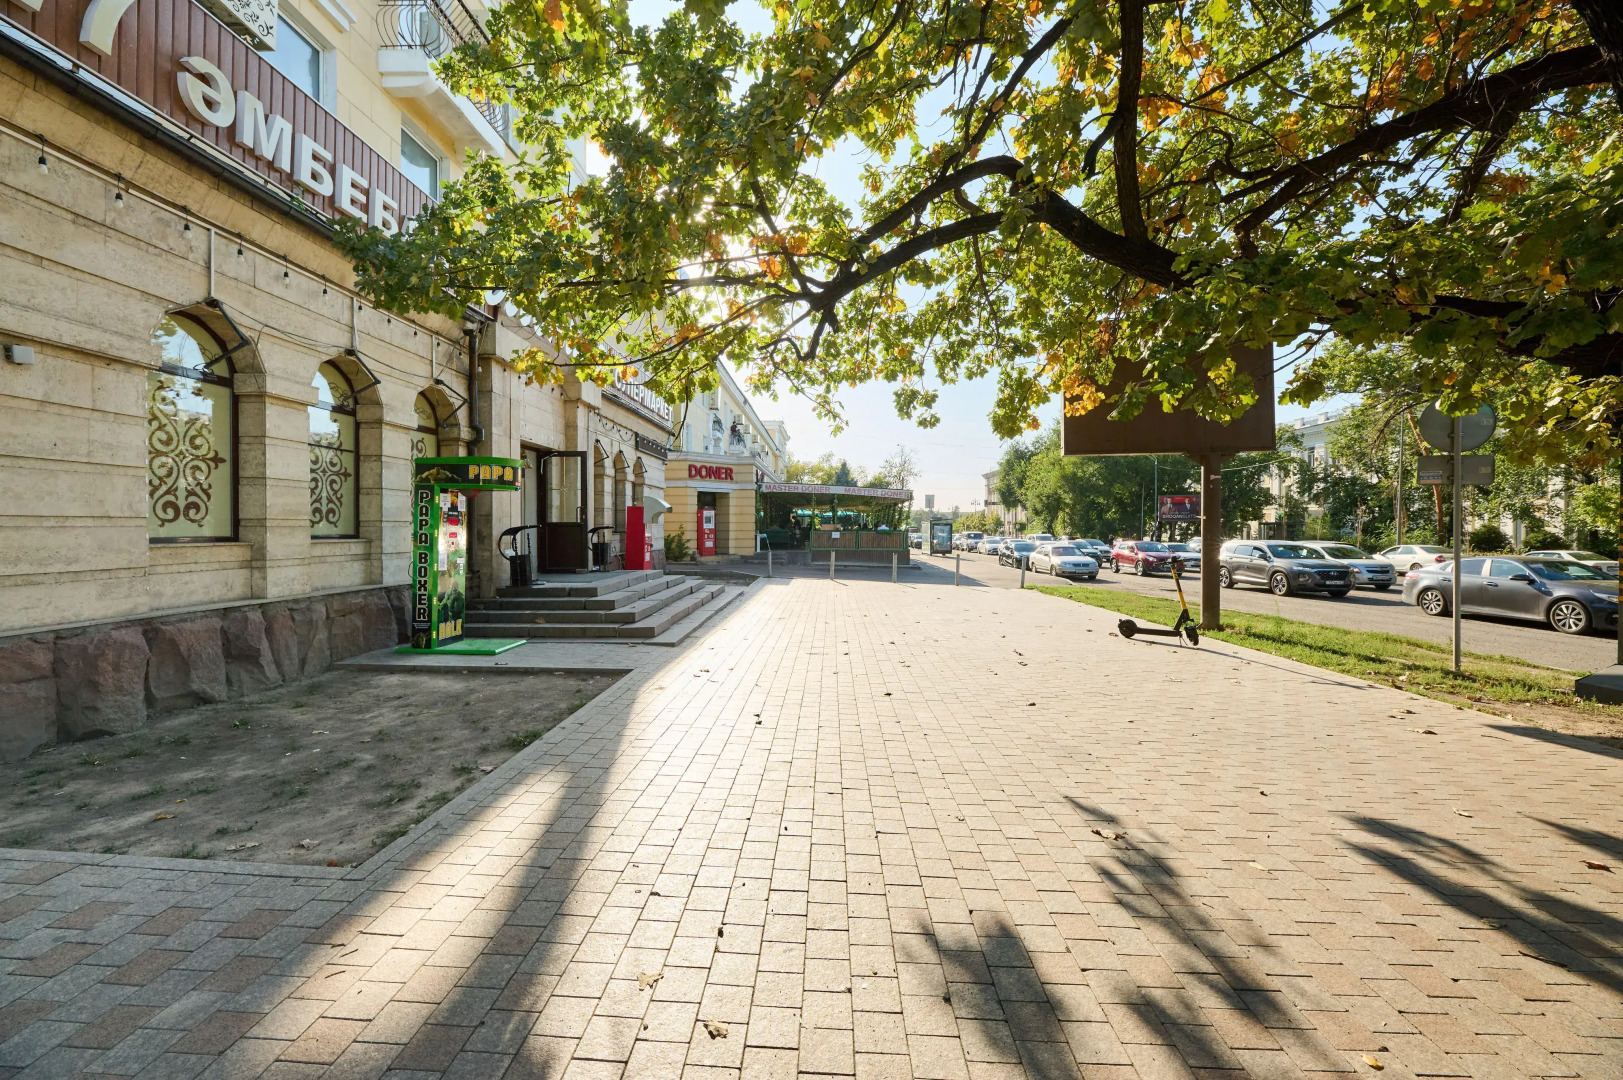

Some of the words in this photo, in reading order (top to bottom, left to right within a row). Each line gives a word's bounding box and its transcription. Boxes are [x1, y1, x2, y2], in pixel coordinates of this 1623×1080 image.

[468, 465, 513, 481] PAPA
[689, 464, 734, 480] DONER
[765, 484, 799, 493] MASTER
[844, 488, 879, 496] MASTER
[418, 490, 430, 545] PAPA
[417, 551, 429, 620] BOXER
